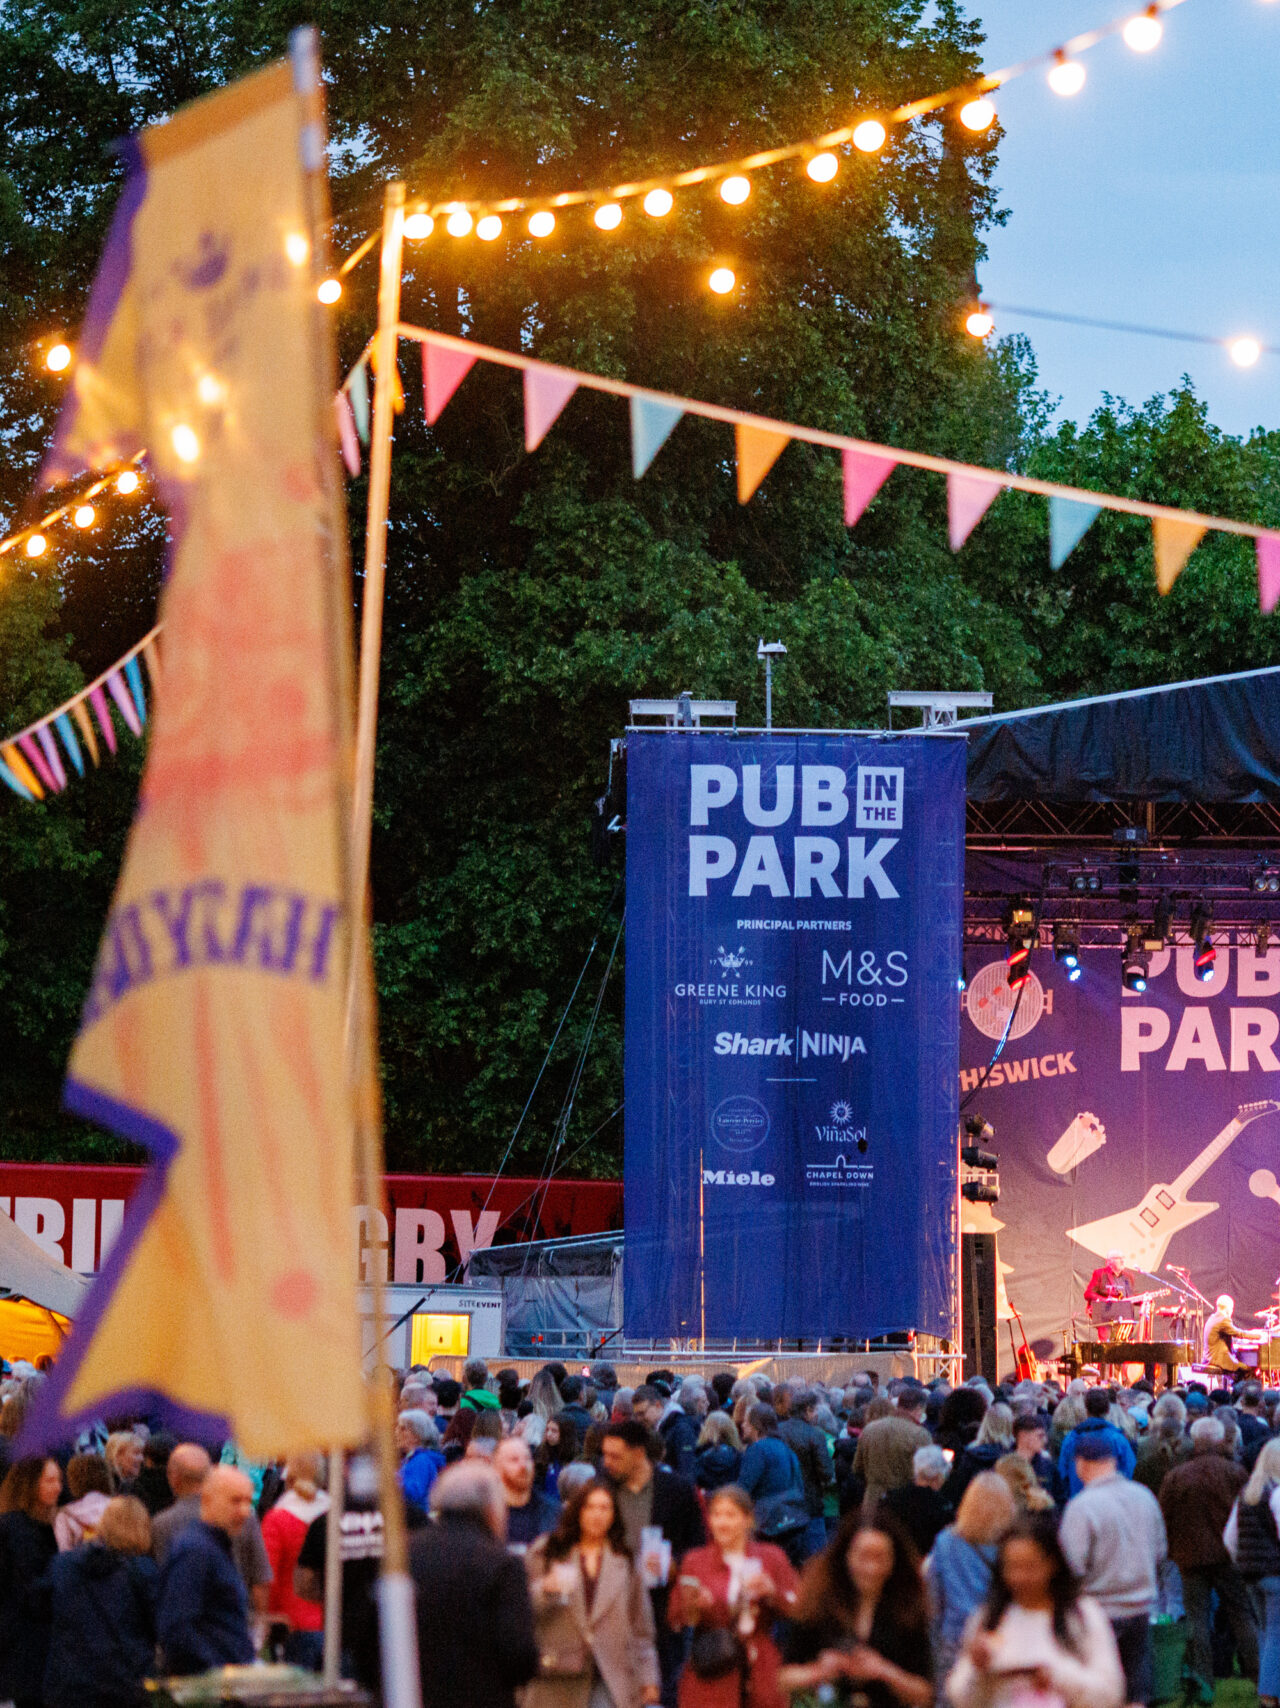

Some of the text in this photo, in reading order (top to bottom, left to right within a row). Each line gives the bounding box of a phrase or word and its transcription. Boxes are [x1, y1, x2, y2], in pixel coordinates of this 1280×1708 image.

[690, 764, 849, 827] PUB
[863, 774, 897, 801] IN
[863, 806, 897, 821] THE
[688, 835, 900, 899] PARK
[737, 919, 852, 931] PRINCIPAL PARTNERS
[822, 949, 908, 987] M&S
[674, 983, 787, 998] GREENE KING
[839, 993, 887, 1007] FOOD
[713, 1032, 794, 1056] Shark
[959, 1051, 1077, 1092] HISWICK
[702, 1170, 775, 1186] Miele
[806, 1171, 843, 1179] CHAPEL
